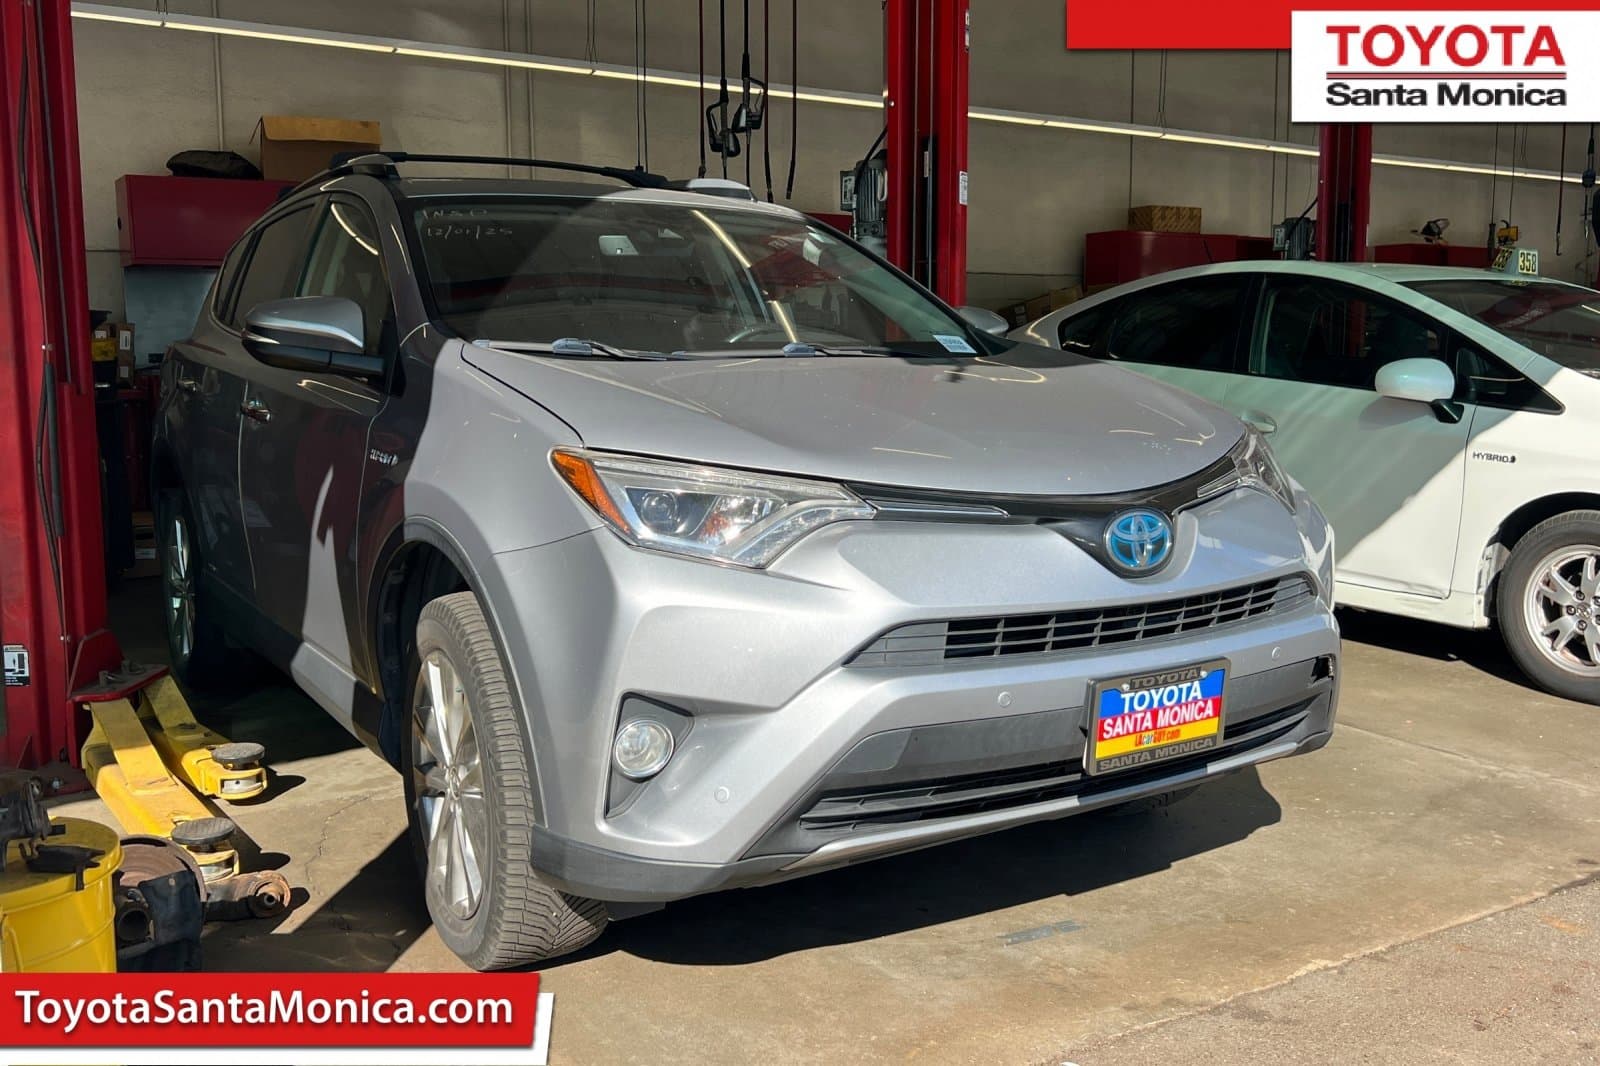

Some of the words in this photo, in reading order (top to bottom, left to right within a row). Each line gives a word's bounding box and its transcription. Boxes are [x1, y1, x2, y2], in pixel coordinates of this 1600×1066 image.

[1519, 252, 1537, 272] 358
[1472, 451, 1509, 463] HYBRID
[1131, 668, 1199, 690] TOYOTA
[1121, 680, 1202, 714] TOYOTA
[1103, 711, 1153, 739] SANTA
[1157, 699, 1213, 728] MONICA
[1100, 751, 1151, 770] SANTA
[1155, 737, 1213, 759] MONICA
